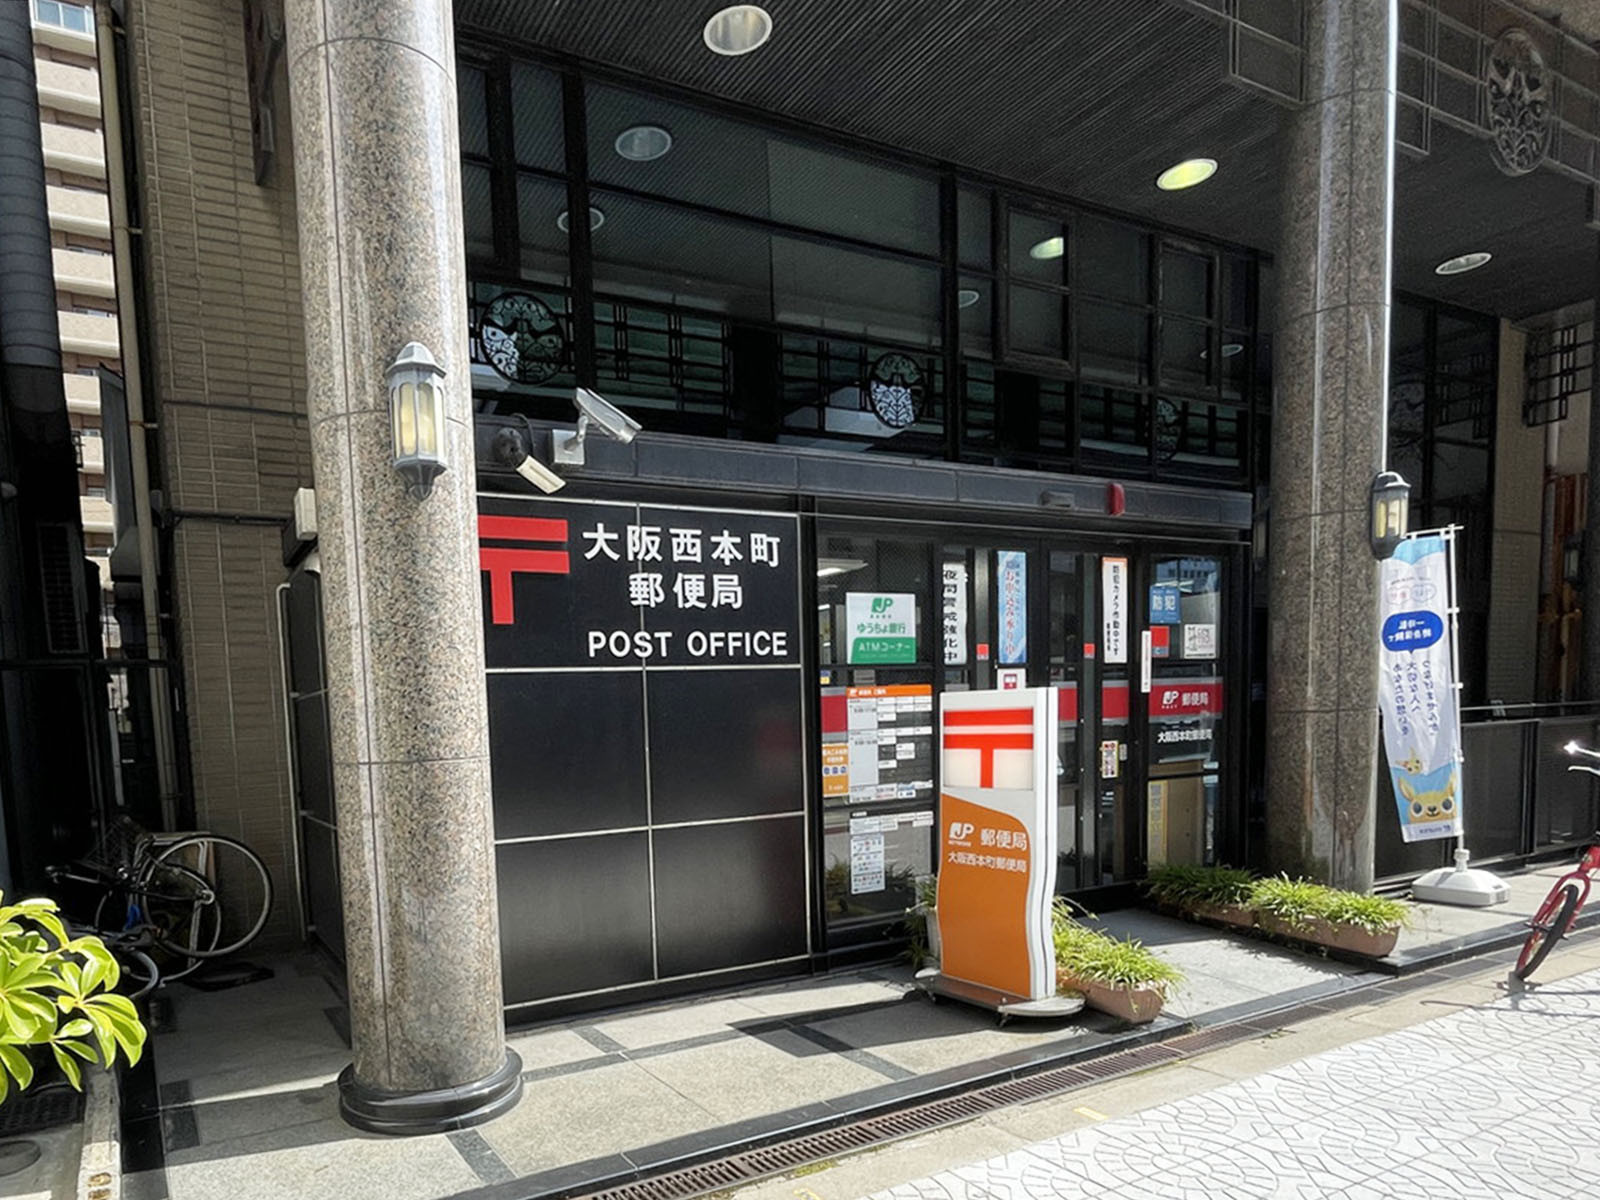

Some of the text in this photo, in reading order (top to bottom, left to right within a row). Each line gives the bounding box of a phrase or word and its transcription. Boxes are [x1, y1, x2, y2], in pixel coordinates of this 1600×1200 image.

[582, 522, 781, 568] 大阪西本町
[628, 572, 743, 610] 郵便局
[857, 622, 906, 635] ゆうちょ銀行
[588, 630, 788, 658] POST OFFICE
[859, 641, 911, 653] ATMコーナー
[1182, 692, 1208, 707] 郵便局
[1157, 729, 1213, 744] 大阪西本町郵便局
[981, 828, 1027, 851] 郵便局
[947, 851, 1026, 873] 大阪西本町郵便局
